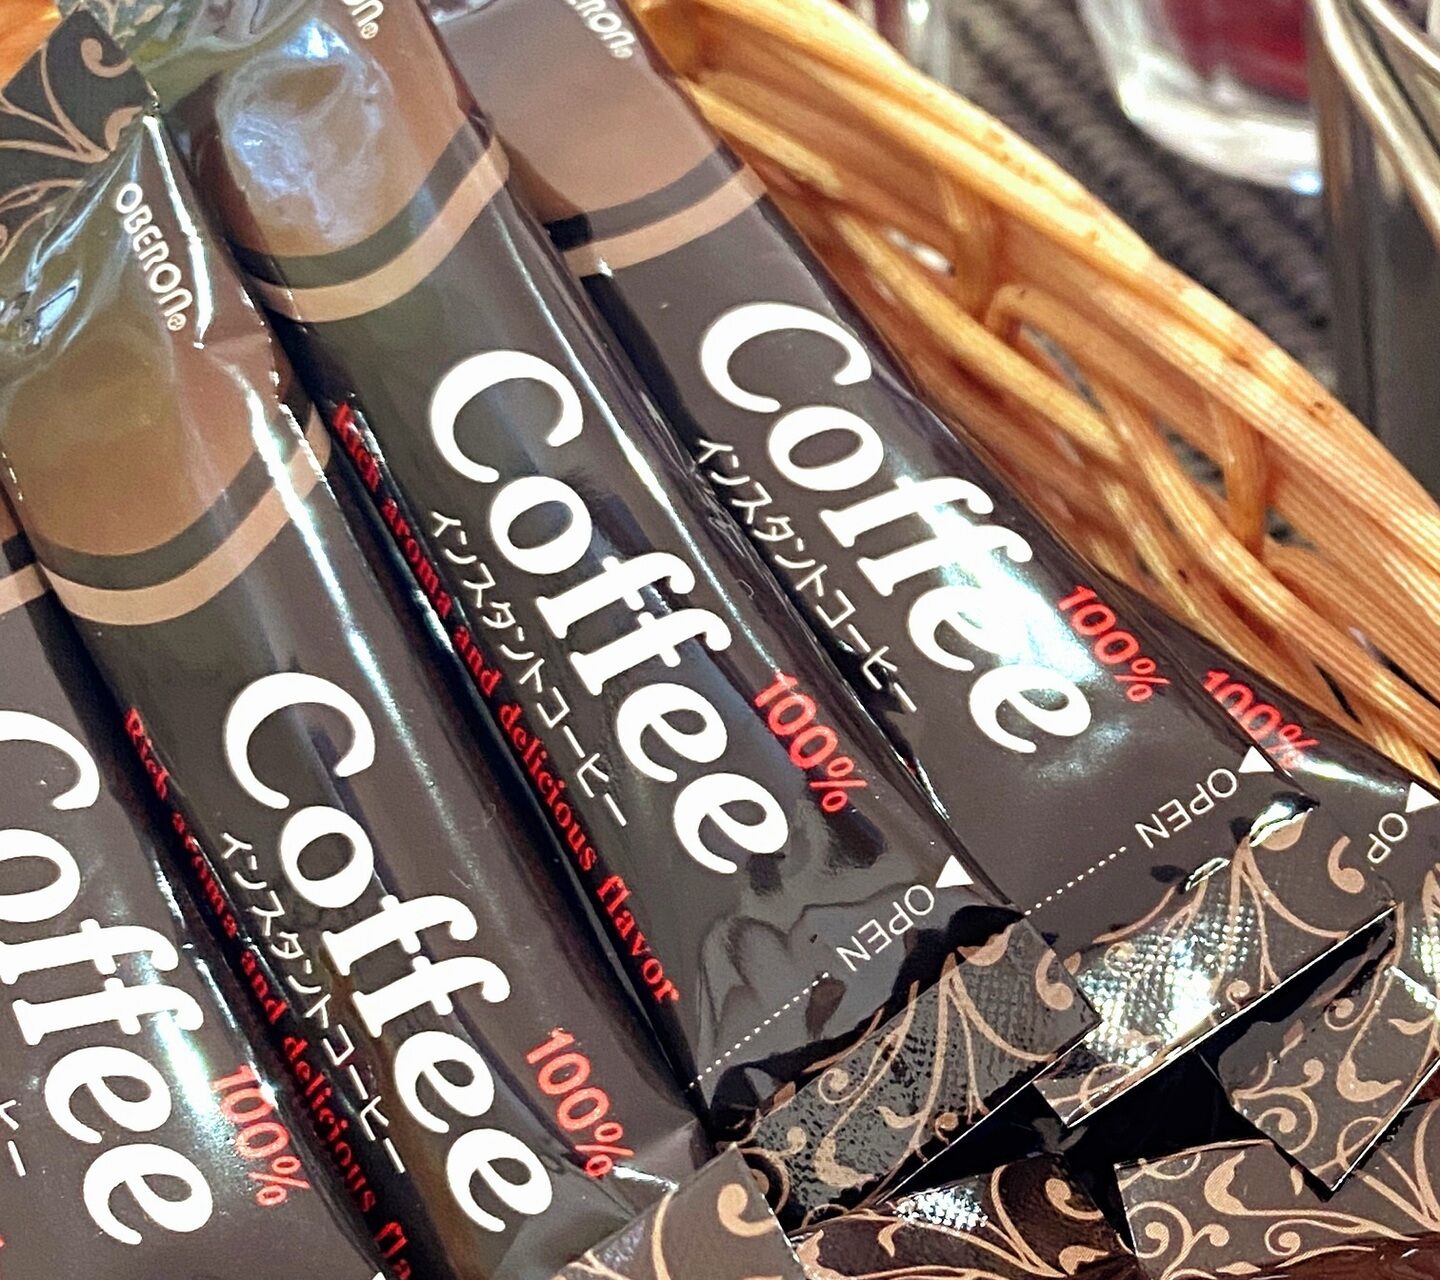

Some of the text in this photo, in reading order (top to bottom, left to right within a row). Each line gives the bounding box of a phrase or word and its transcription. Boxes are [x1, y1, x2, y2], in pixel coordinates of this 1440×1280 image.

[429, 349, 790, 874] Coffee
[695, 436, 918, 712] インスタントコーヒー
[700, 301, 1093, 754] Coffee
[1055, 583, 1172, 703] 100%
[431, 510, 628, 827] インスタントコーヒー
[753, 670, 868, 814] 100%
[1202, 667, 1321, 771] 100%
[452, 624, 502, 698] and
[498, 702, 599, 872] delicious
[596, 874, 682, 1005] flavor
[834, 882, 937, 974] OPEN
[1133, 766, 1240, 850] OPEN
[0, 709, 214, 1246] Coffee
[222, 832, 406, 1174] インスタントコーヒー
[225, 671, 554, 1232] Coffee
[240, 949, 289, 1024] and
[281, 1034, 378, 1213] delicious
[211, 1063, 311, 1208] 100%
[526, 1026, 636, 1179] 100%
